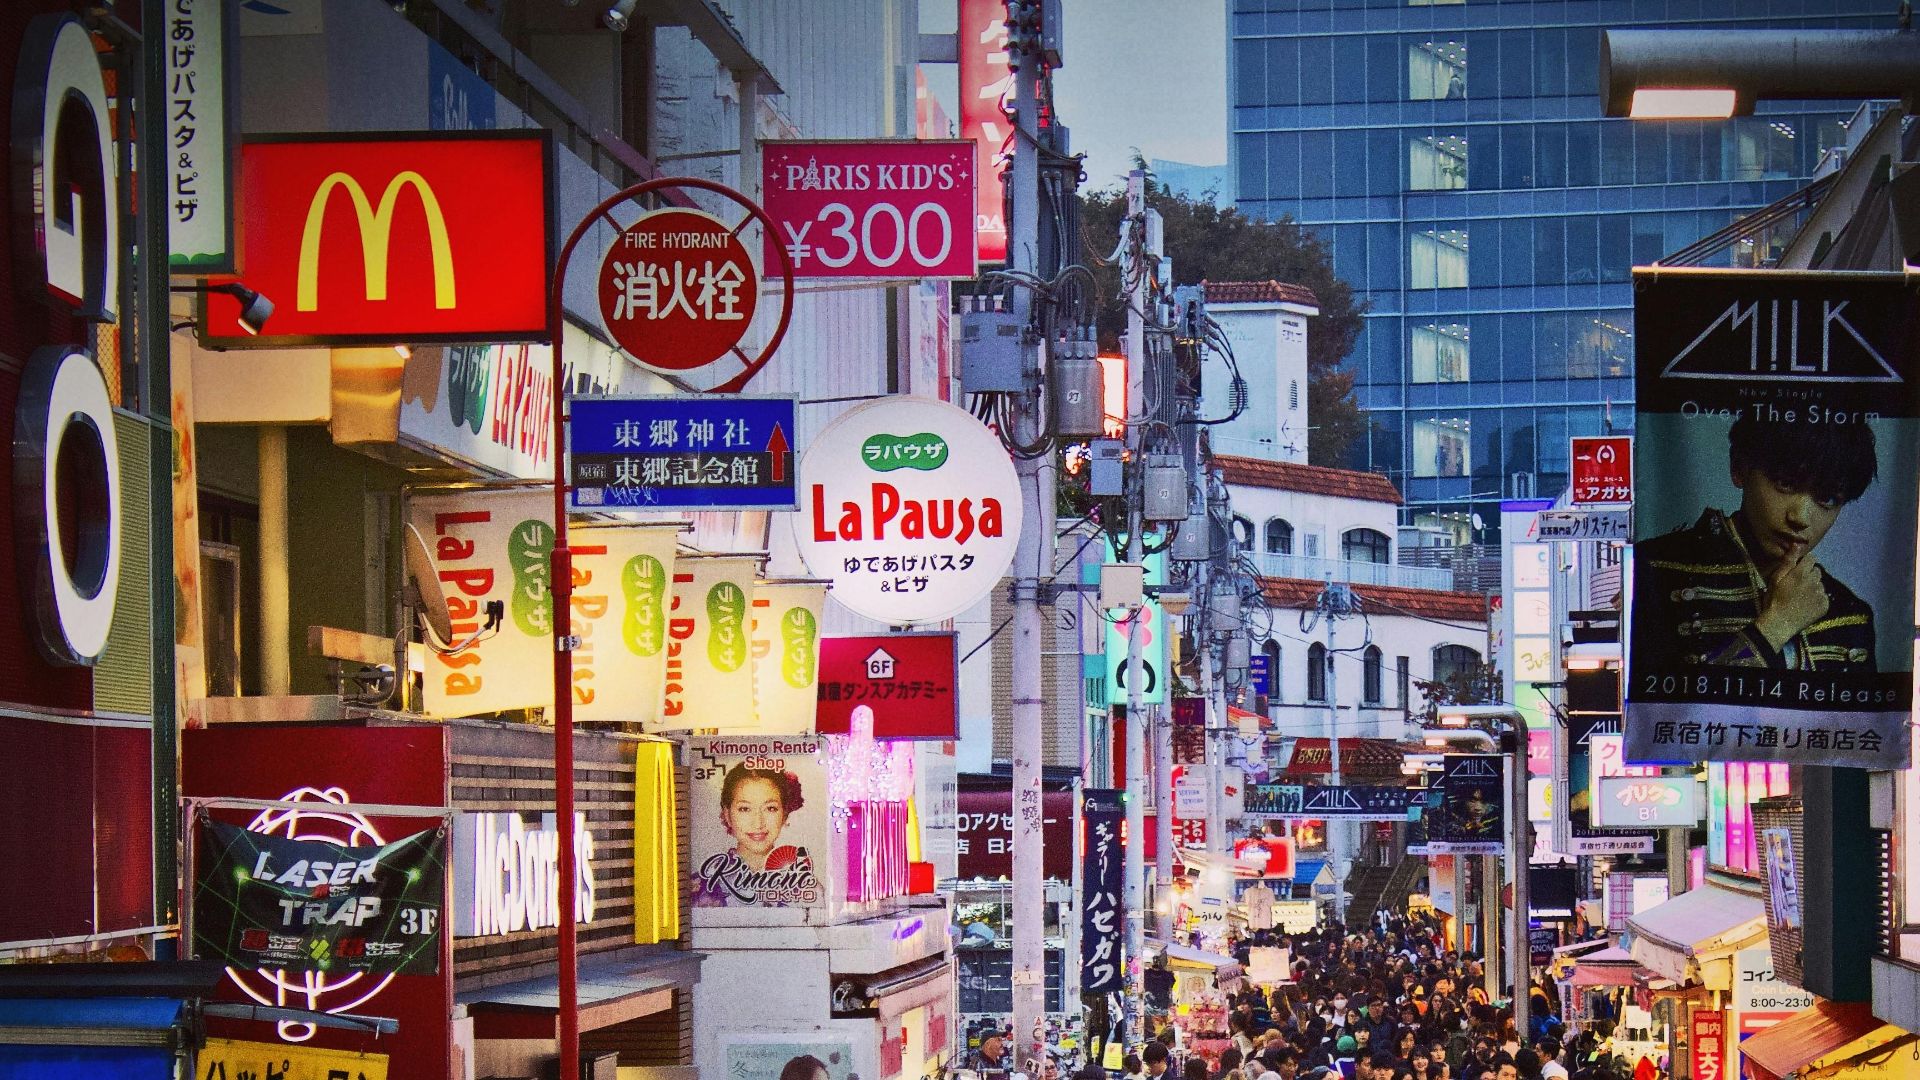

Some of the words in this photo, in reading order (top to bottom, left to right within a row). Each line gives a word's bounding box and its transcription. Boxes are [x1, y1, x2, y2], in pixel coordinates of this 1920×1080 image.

[785, 155, 871, 192] PARIS
[877, 164, 953, 191] KID'S
[625, 232, 656, 249] FIRE
[662, 232, 730, 250] HYDRANT
[783, 202, 952, 270] ¥300
[613, 260, 746, 320] 消火栓
[1680, 400, 1744, 420] Over
[1752, 403, 1797, 422] The
[1807, 404, 1881, 425] Storm
[612, 418, 751, 448] 東郷神社
[864, 442, 945, 460] ラパウザ
[612, 456, 759, 486] 東郷記念館
[1586, 486, 1630, 500] アガサ
[812, 484, 863, 543] La
[871, 482, 1003, 546] Pausa
[844, 553, 976, 574] ゆであげパスタ
[880, 575, 930, 593] &ピザ
[870, 660, 891, 674] 6F
[1644, 675, 1783, 699] 2018.11.14
[1798, 682, 1897, 703] Release
[709, 740, 767, 754] Kimono
[1652, 720, 1883, 753] 原宿竹下通り商店会
[695, 767, 716, 780] 3F
[745, 756, 785, 772] Shop
[252, 851, 380, 889] LASER
[700, 852, 817, 906] Kimono
[756, 890, 816, 903] TOKYO
[279, 896, 382, 928] TRAP
[400, 908, 438, 936] 3F
